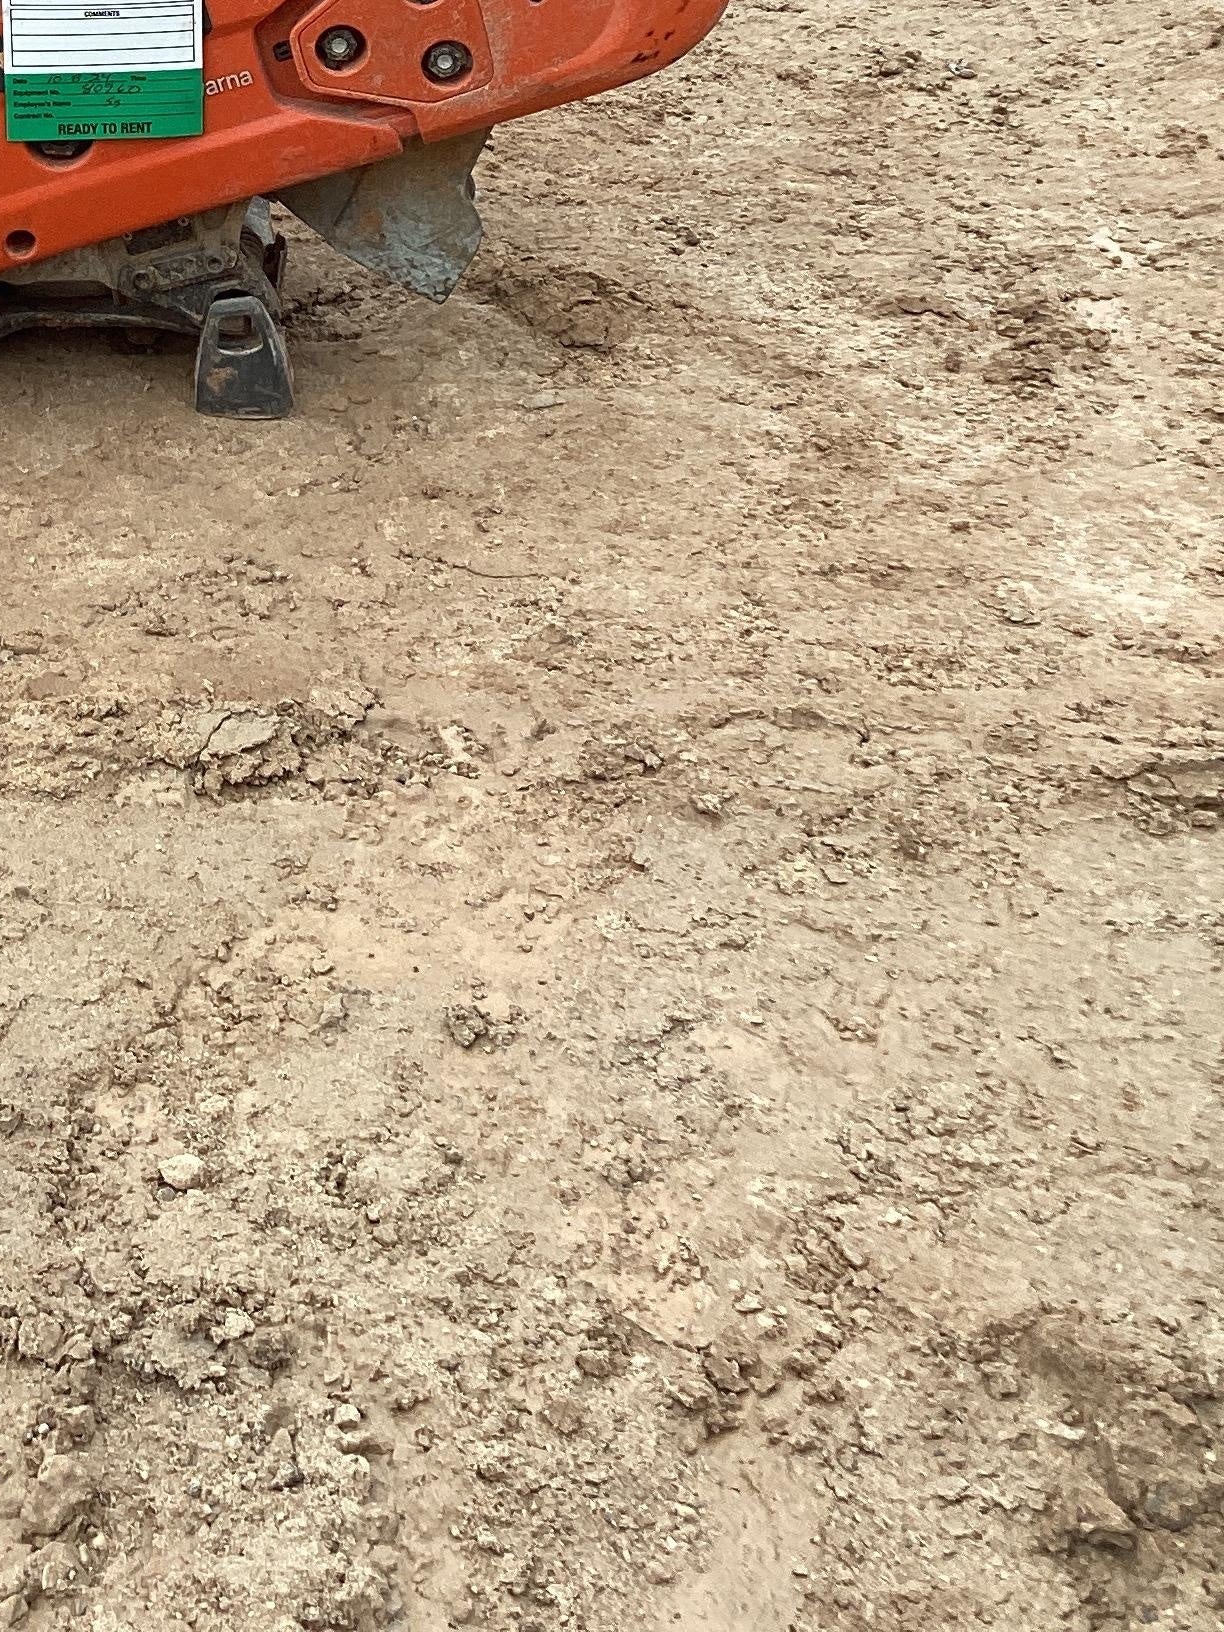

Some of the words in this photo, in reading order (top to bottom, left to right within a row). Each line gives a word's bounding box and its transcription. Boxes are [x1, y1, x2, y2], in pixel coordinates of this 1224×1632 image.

[84, 10, 121, 18] COMMENTS
[58, 123, 98, 136] READY
[101, 123, 118, 135] TO
[120, 121, 153, 134] RENT
